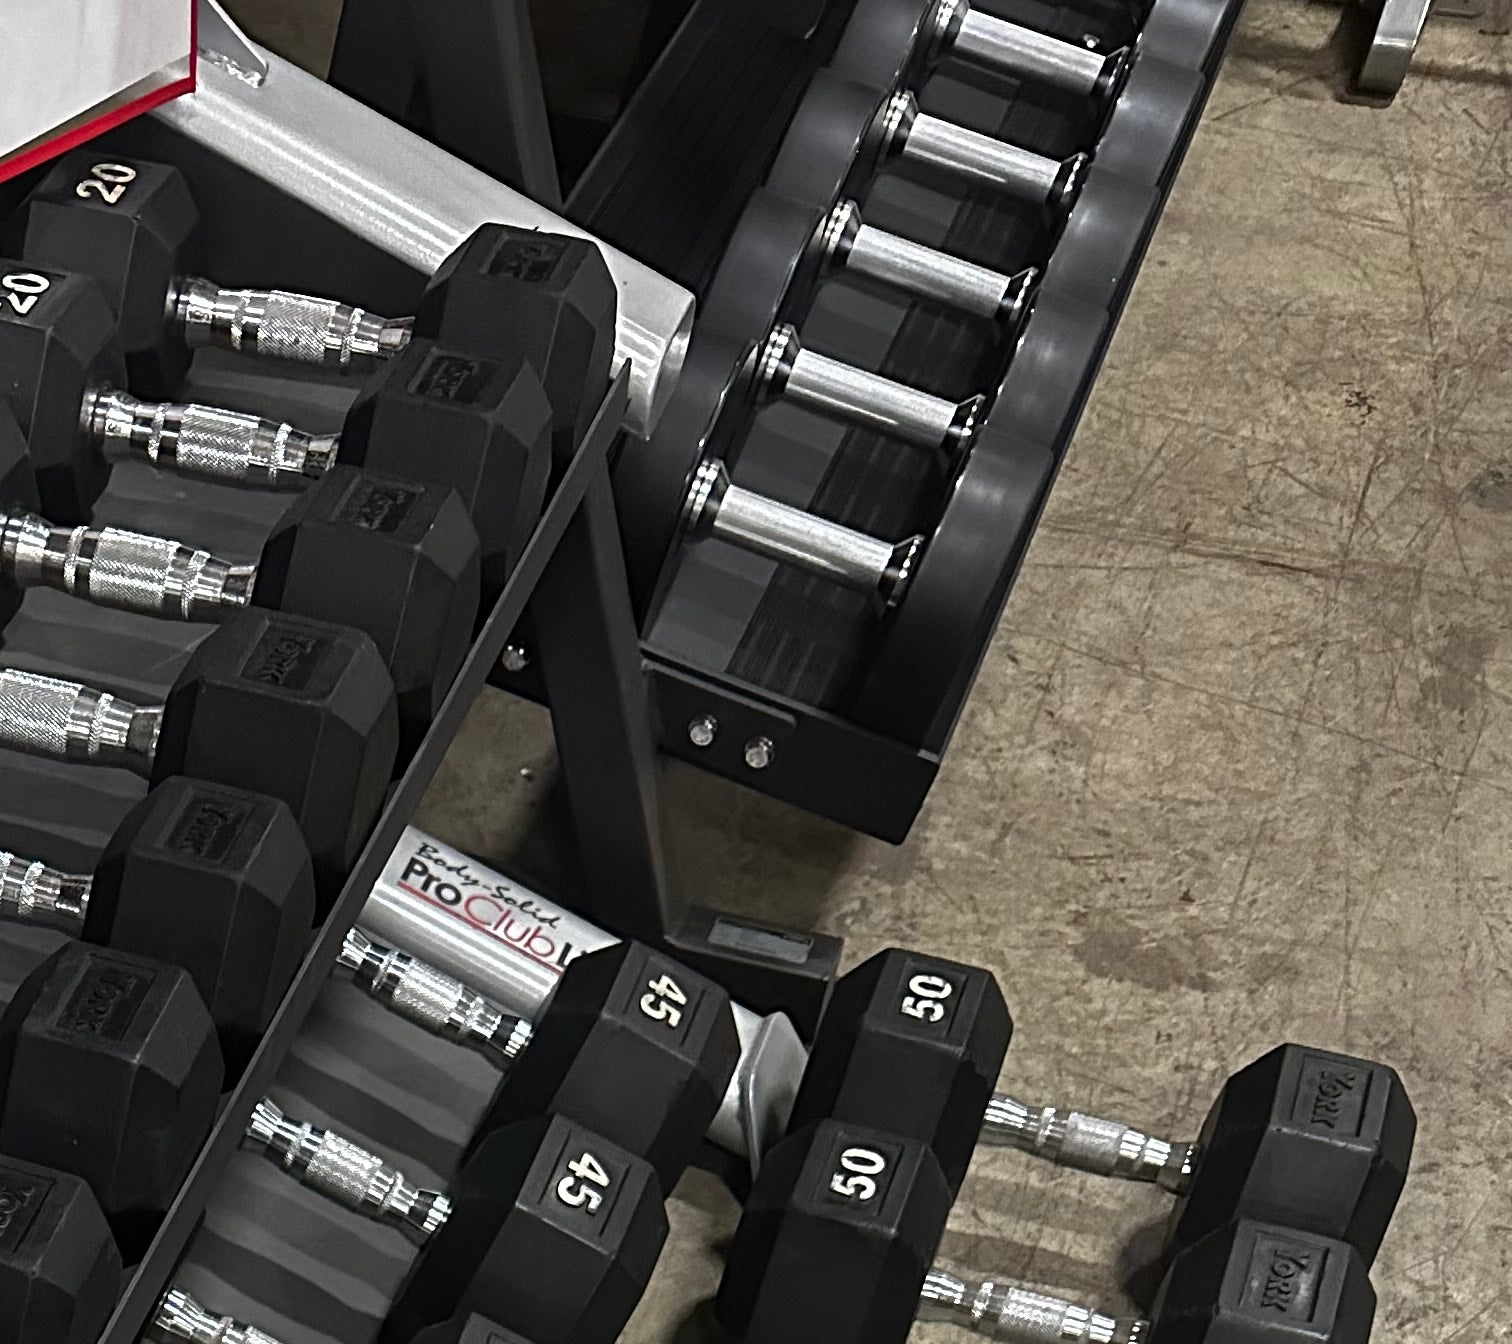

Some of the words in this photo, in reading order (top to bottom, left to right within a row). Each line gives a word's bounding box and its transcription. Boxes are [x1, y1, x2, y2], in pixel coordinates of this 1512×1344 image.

[77, 164, 136, 203] 20
[416, 842, 560, 929] Body-Solid
[641, 975, 686, 1026] 45
[902, 976, 951, 1021] 50
[558, 1154, 609, 1209] 45
[831, 1149, 884, 1199] 50
